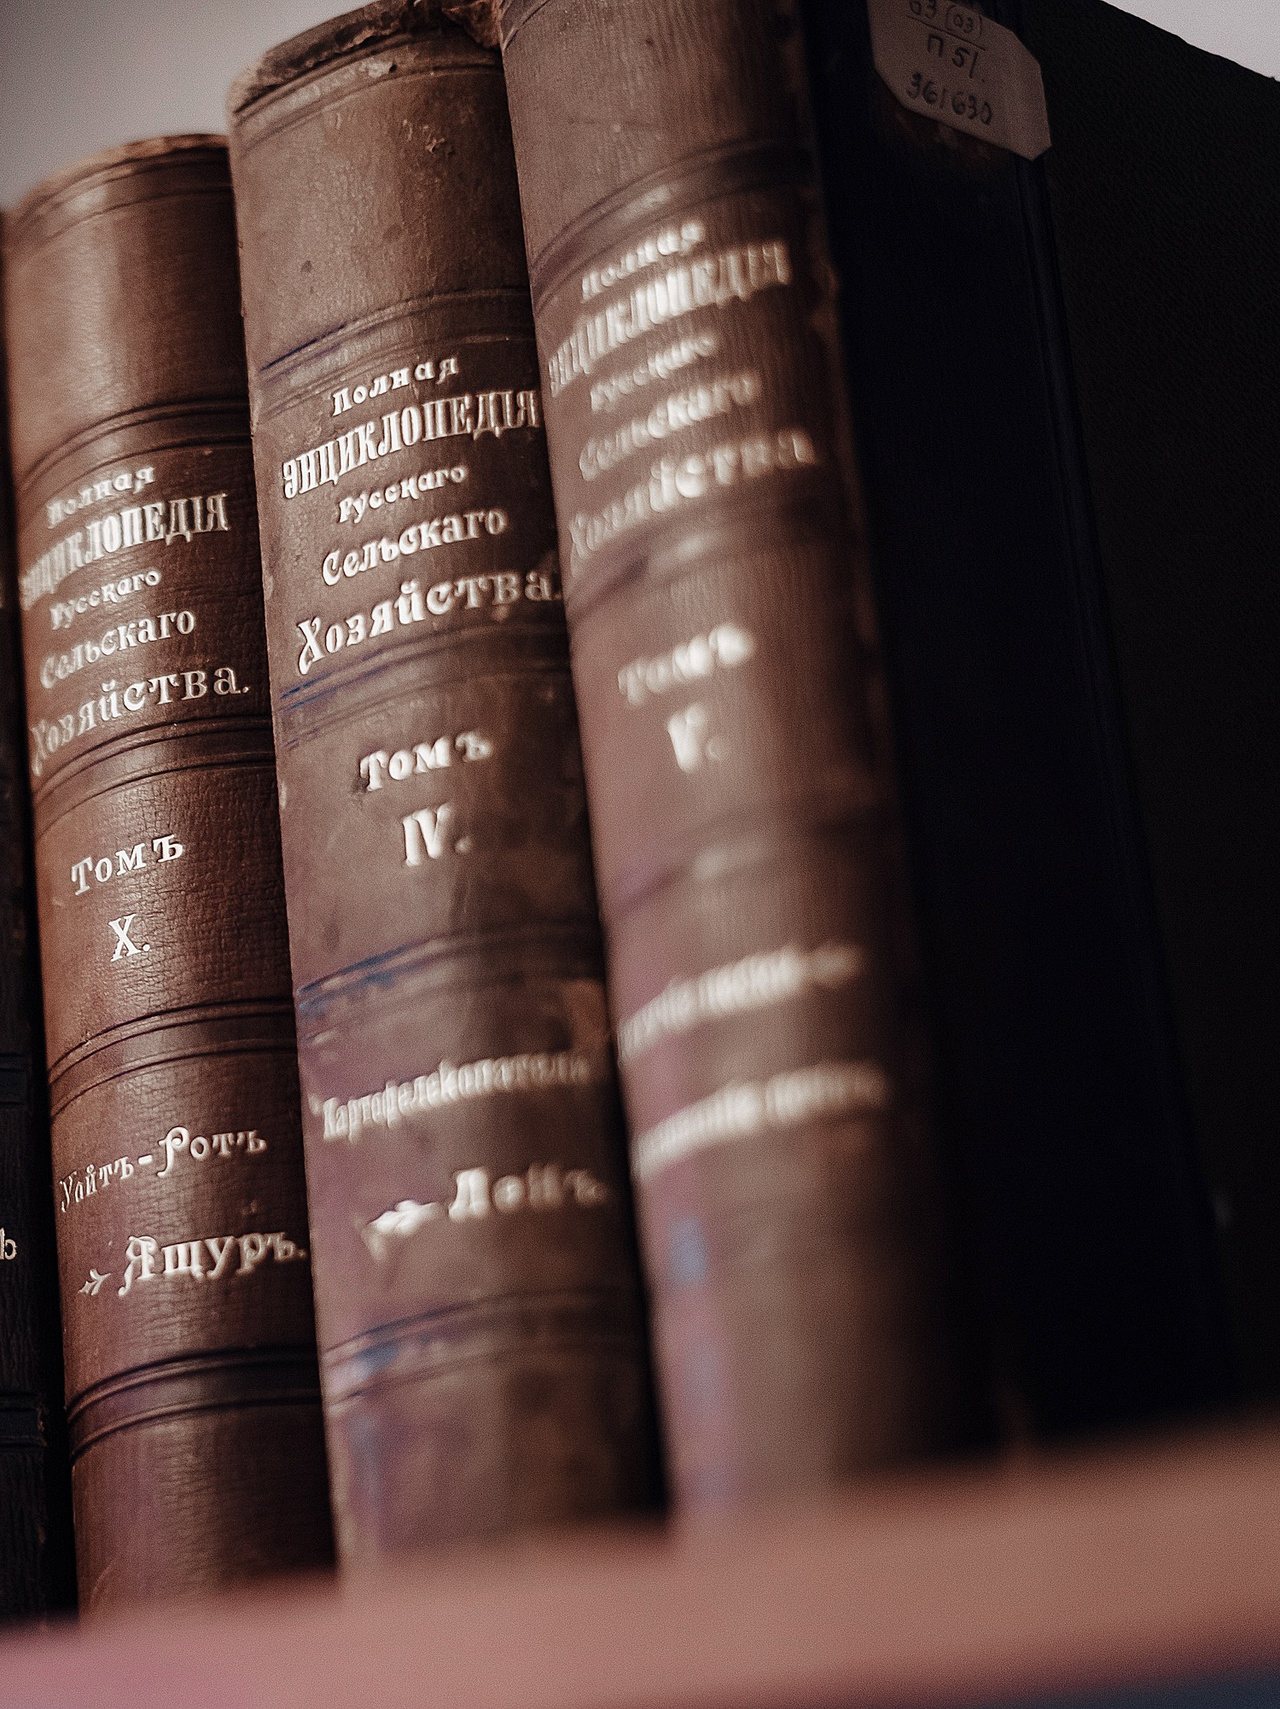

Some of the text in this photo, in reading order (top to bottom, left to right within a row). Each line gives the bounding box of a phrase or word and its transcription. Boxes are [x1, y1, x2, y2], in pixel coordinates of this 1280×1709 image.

[331, 356, 460, 417] Полная
[282, 391, 541, 500] ЭНЦИКЛОПЕДІЯ
[322, 509, 508, 586] Сельскаго
[39, 610, 196, 690] Сельскаго
[30, 667, 250, 777] Хозяйства.
[360, 730, 494, 791] Томъ
[71, 834, 184, 896] Томъ
[402, 802, 472, 867] IV.
[108, 913, 151, 962] X.
[118, 1231, 307, 1297] Ящуръ.
